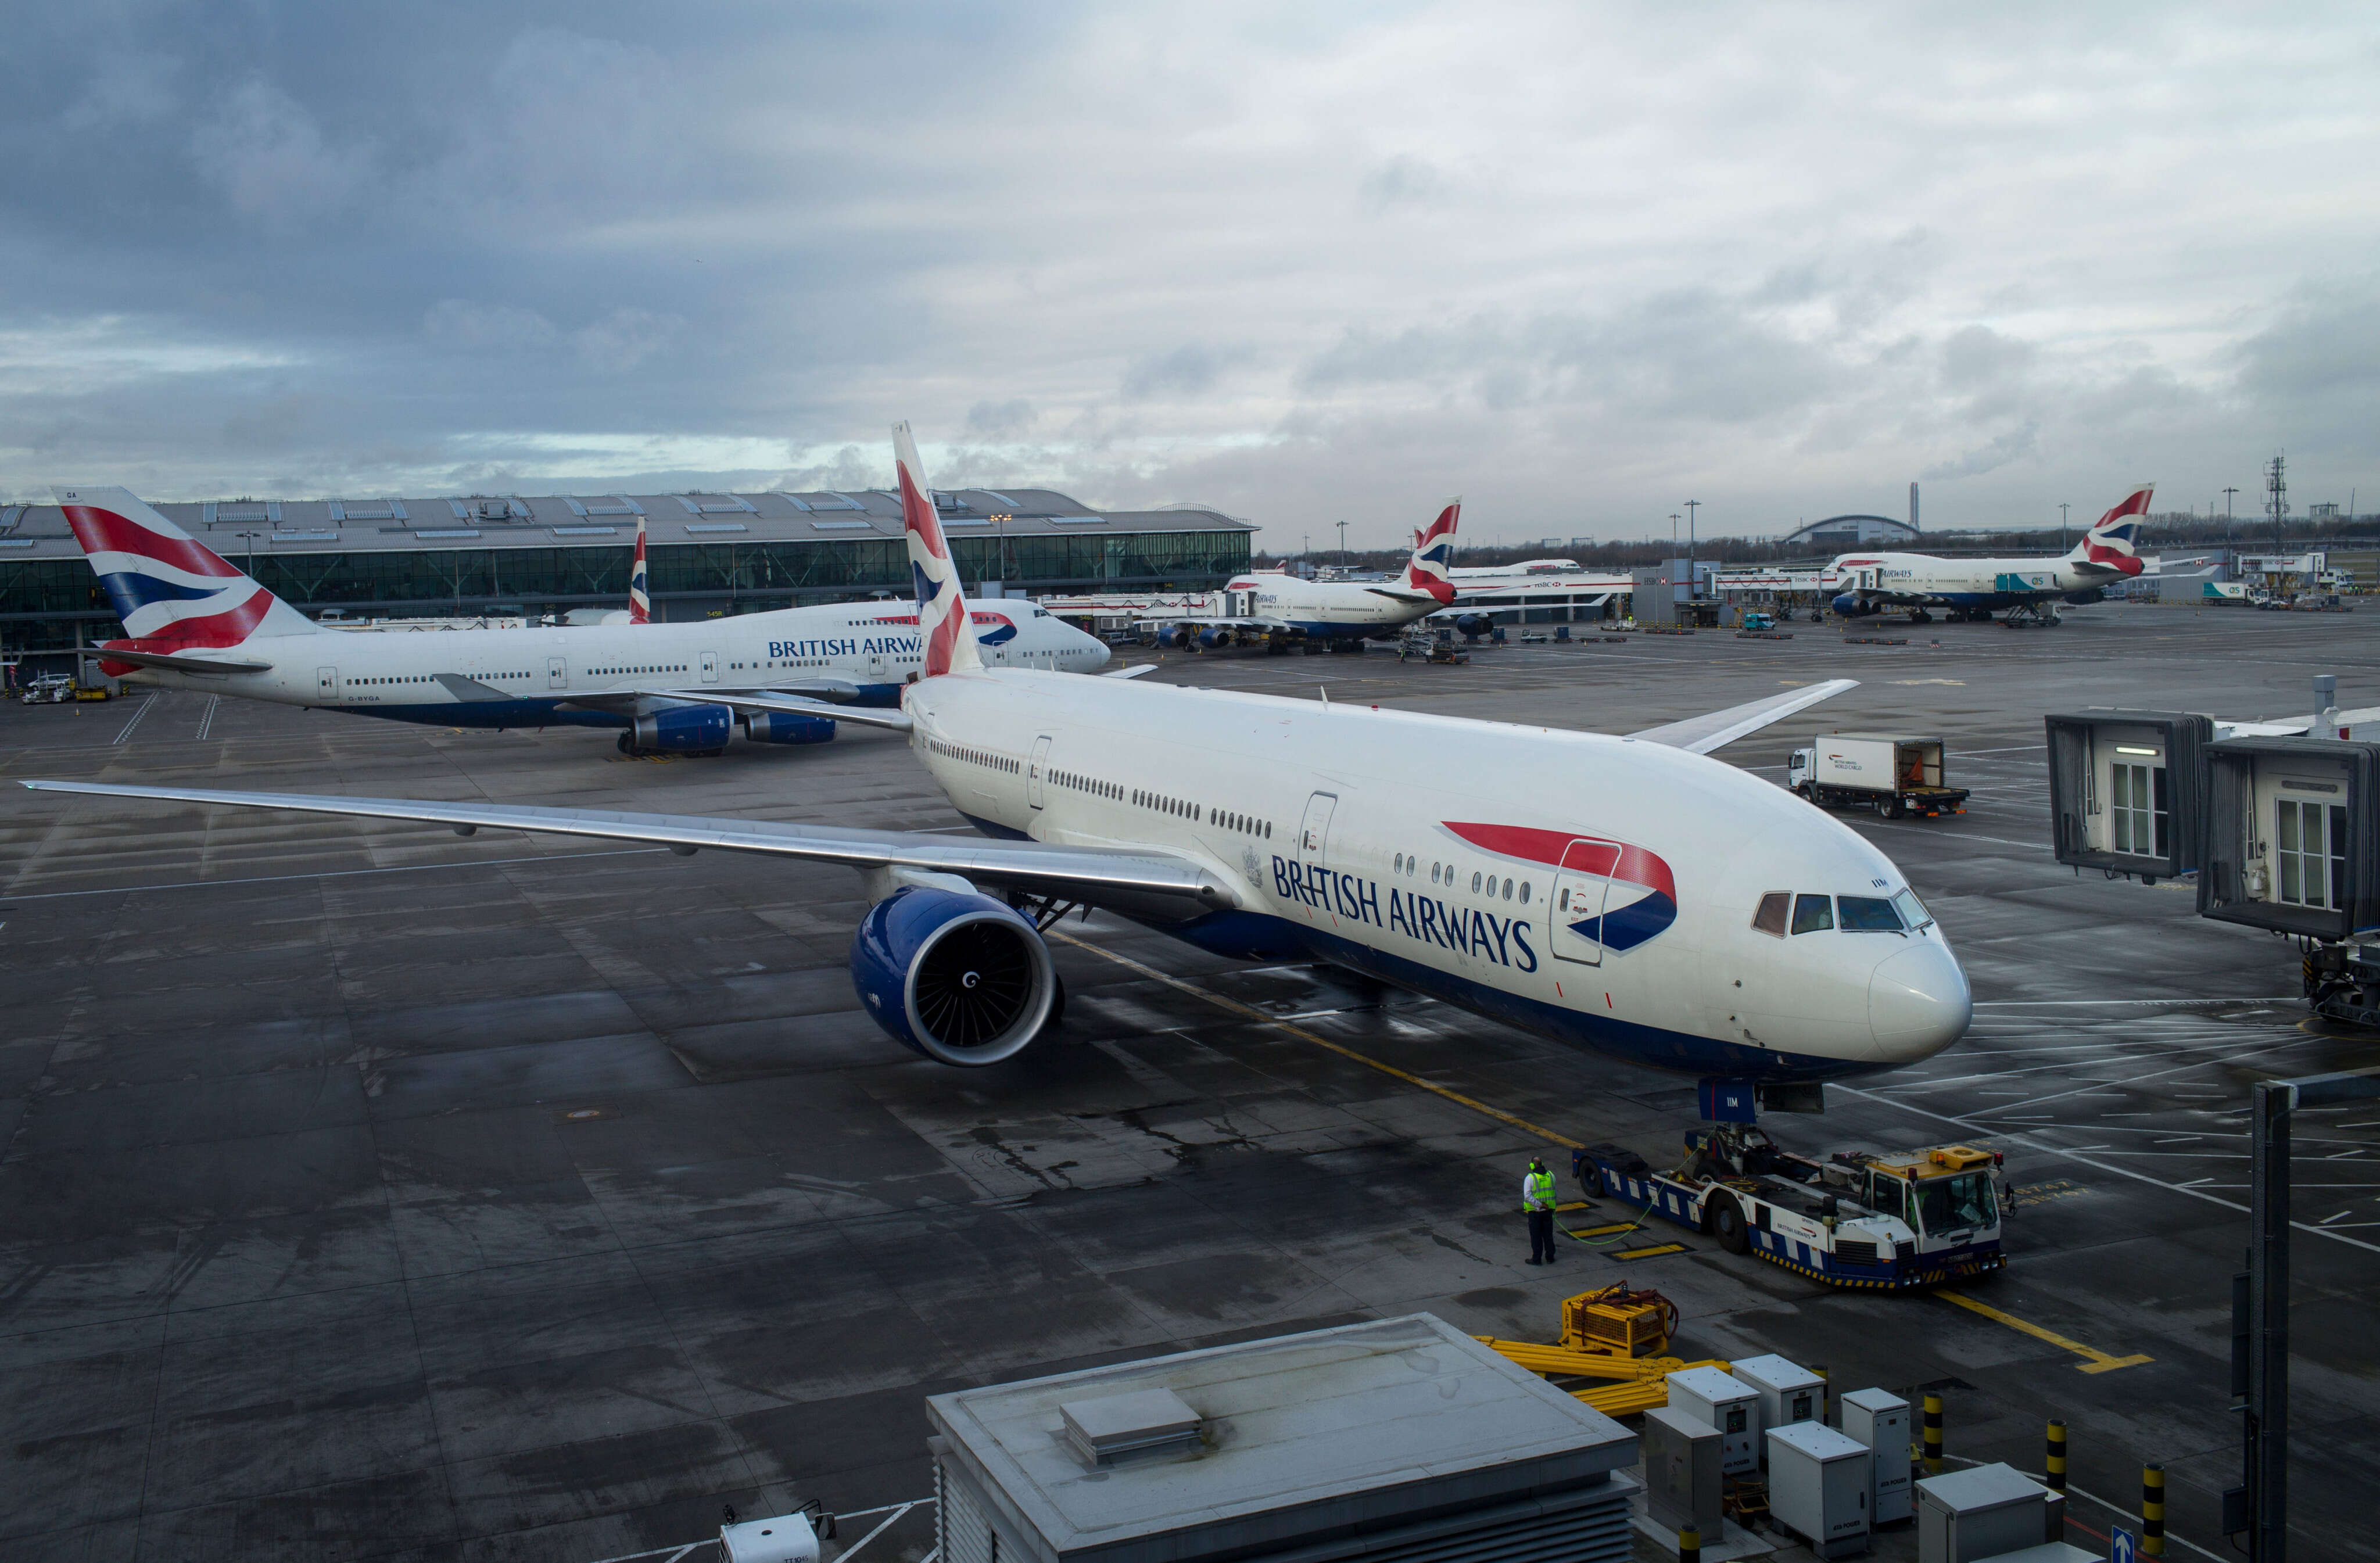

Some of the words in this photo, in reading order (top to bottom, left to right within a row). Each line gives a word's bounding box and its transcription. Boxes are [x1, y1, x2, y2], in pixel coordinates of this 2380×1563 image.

[1644, 577, 1659, 586] HSBC
[1255, 594, 1278, 604] AIRWAYS
[768, 639, 856, 657] BRITISH
[1272, 855, 1383, 928] BRITISH
[1390, 888, 1537, 973] AIRWAYS
[1777, 1223, 1793, 1232] BRITISH
[1793, 1229, 1811, 1239] AIRWAYS
[1890, 1477, 1906, 1486] POWER
[1843, 1520, 1861, 1529] POWER
